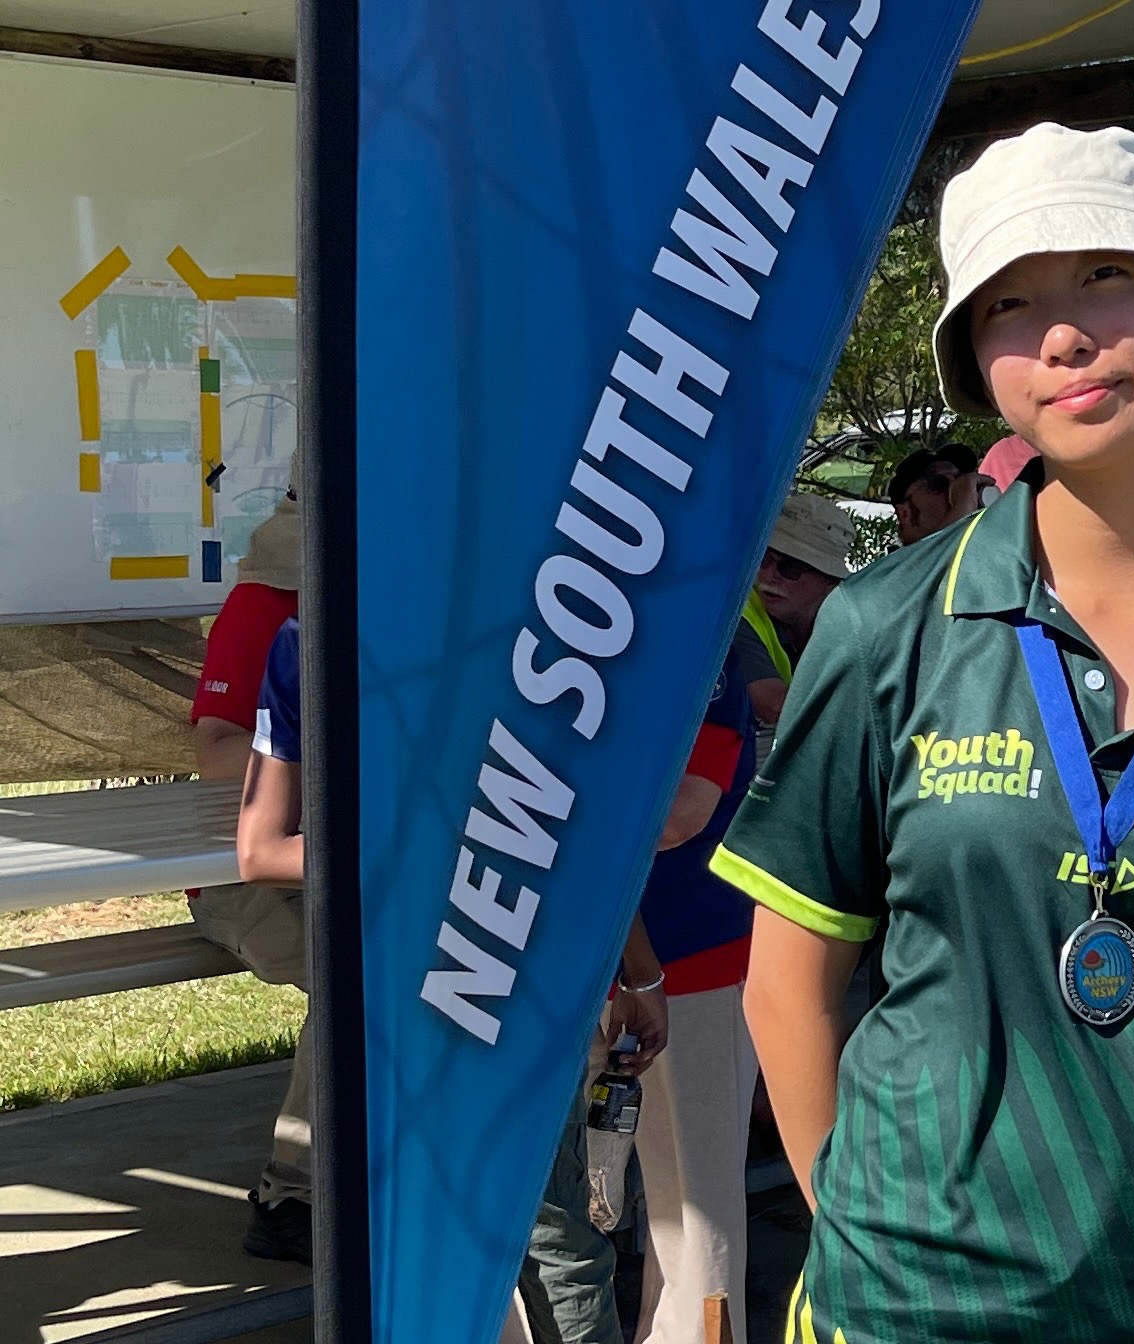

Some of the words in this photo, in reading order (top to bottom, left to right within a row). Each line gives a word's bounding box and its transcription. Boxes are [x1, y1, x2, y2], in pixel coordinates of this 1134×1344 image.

[419, 719, 577, 1046] NEW
[512, 309, 731, 741] SOUTH
[911, 729, 1034, 770] Youth
[918, 768, 1042, 804] Squad!
[1083, 975, 1126, 987] Archery
[1090, 986, 1119, 998] NSW
